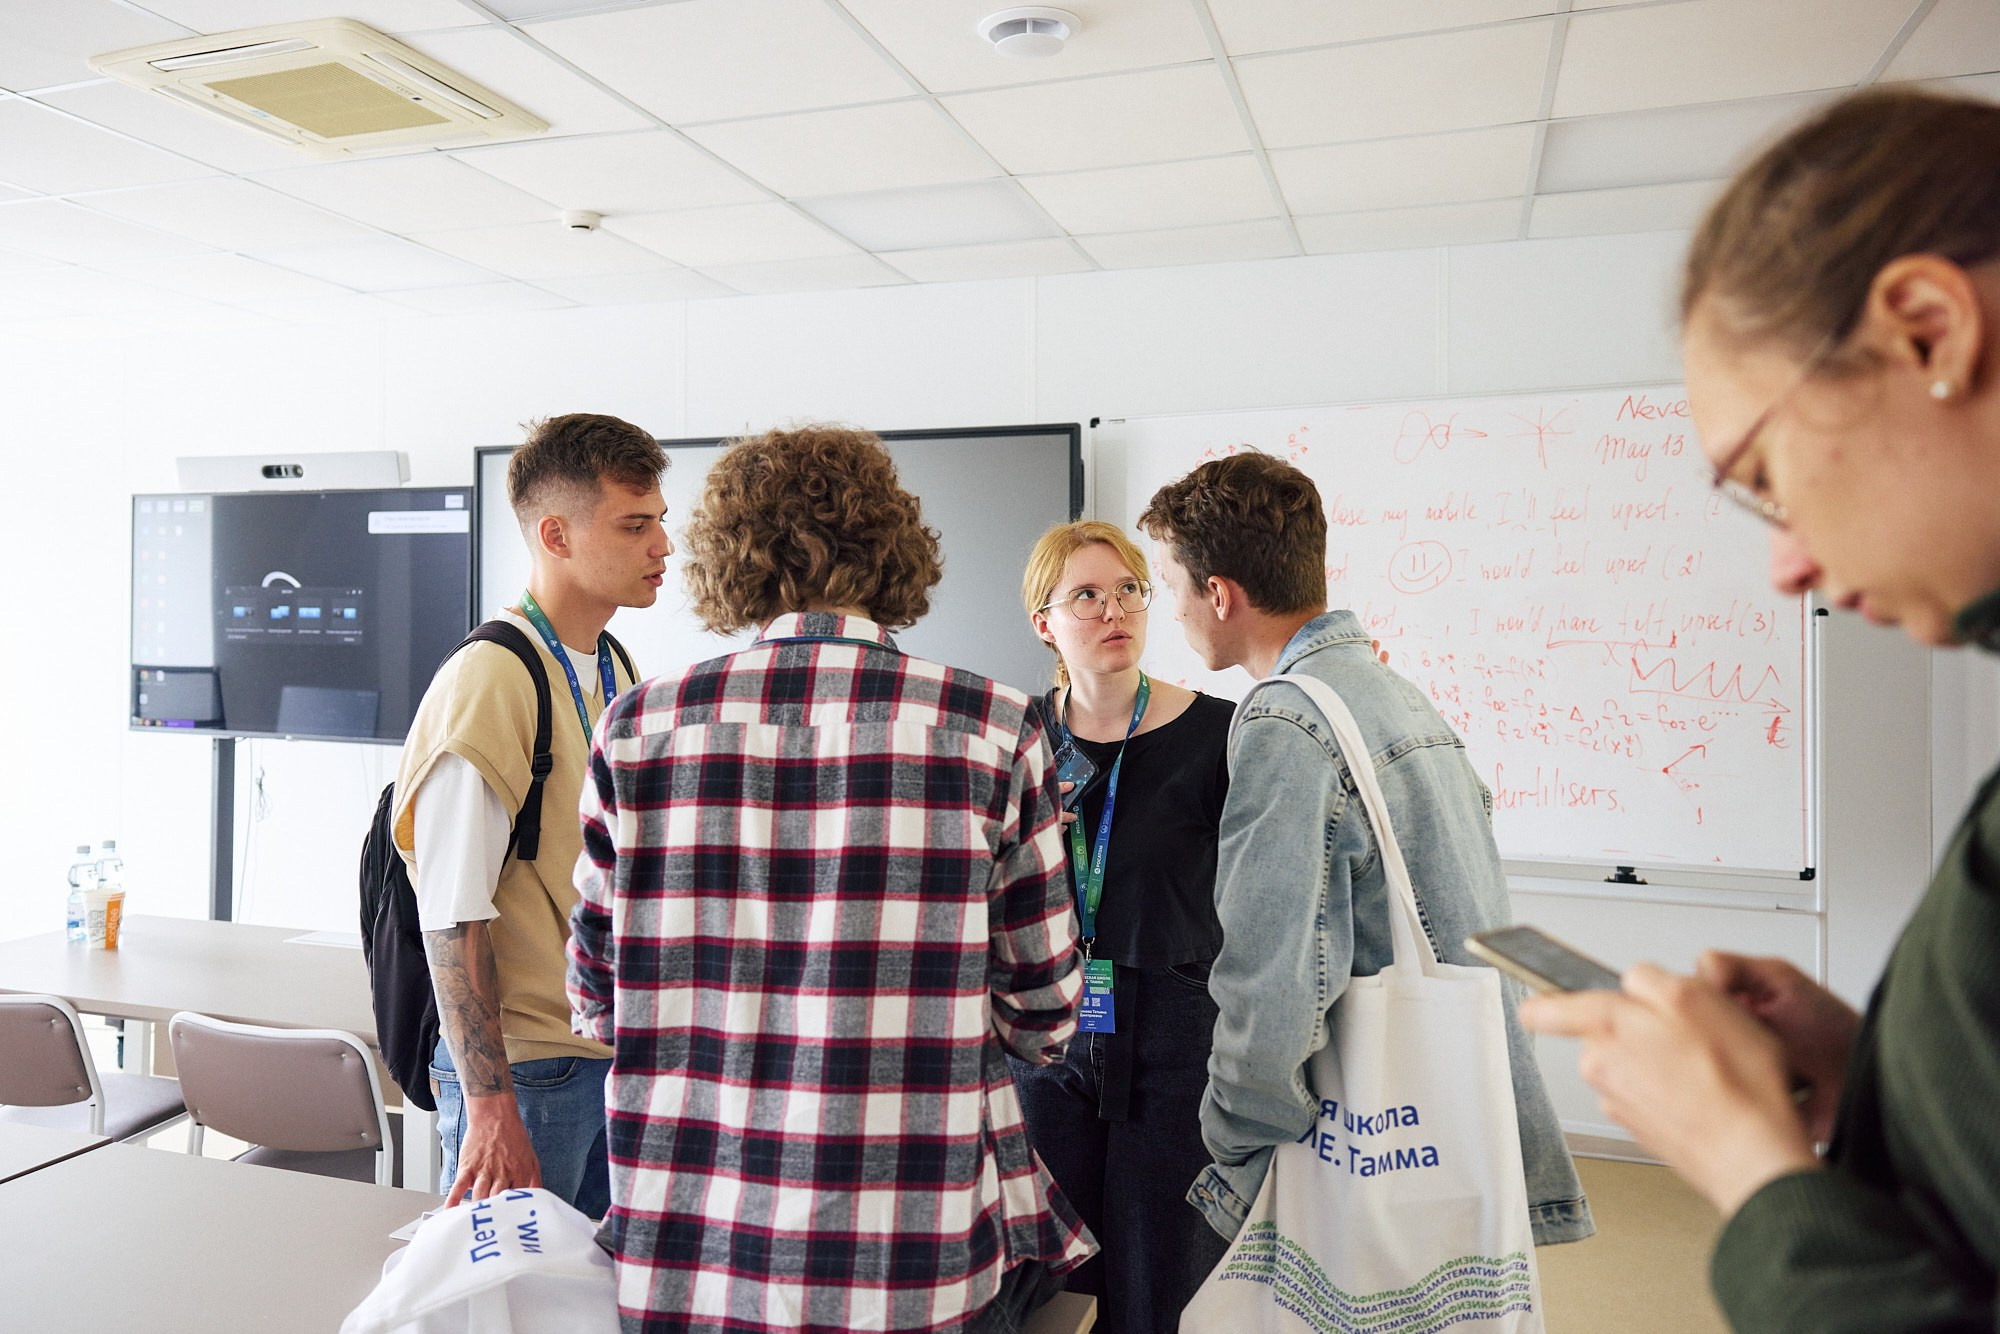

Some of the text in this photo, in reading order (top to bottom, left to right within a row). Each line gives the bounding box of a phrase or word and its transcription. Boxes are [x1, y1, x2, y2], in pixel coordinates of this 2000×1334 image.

[1595, 433, 1651, 482] May
[1382, 508, 1409, 540] my
[1316, 1099, 1420, 1136] я школа
[1348, 1144, 1440, 1178] Тамма
